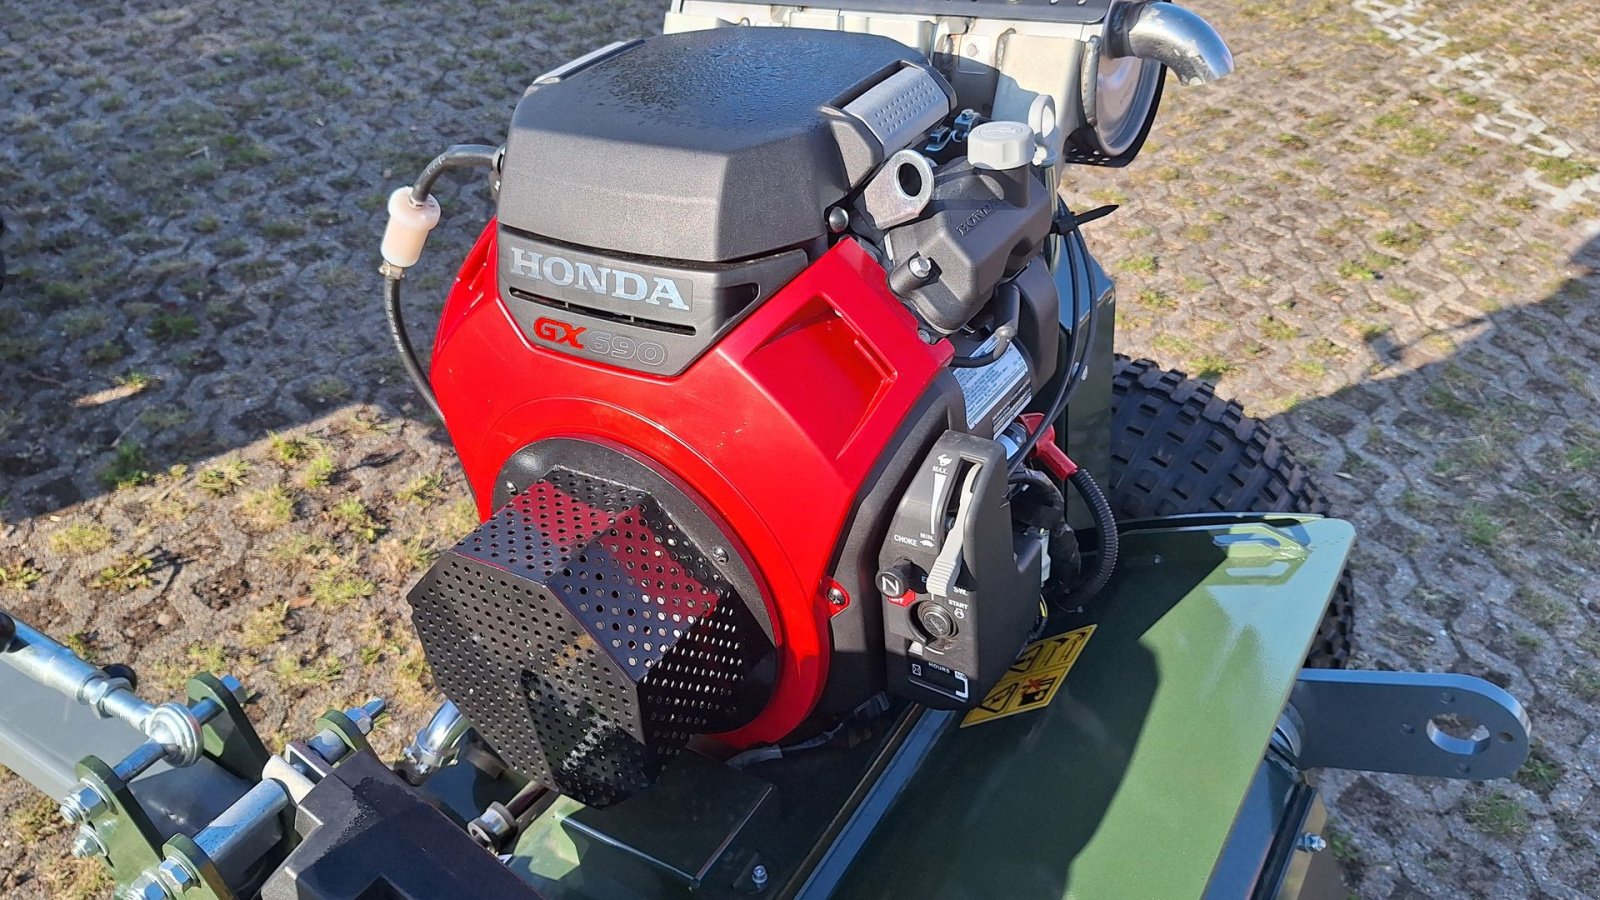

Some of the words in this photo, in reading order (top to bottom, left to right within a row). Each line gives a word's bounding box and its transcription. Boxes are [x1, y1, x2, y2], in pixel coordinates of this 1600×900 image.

[510, 247, 689, 311] HONDA
[534, 317, 666, 366] GX690
[893, 534, 918, 547] CHOKE
[948, 599, 968, 610] START
[928, 661, 951, 673] HOURS
